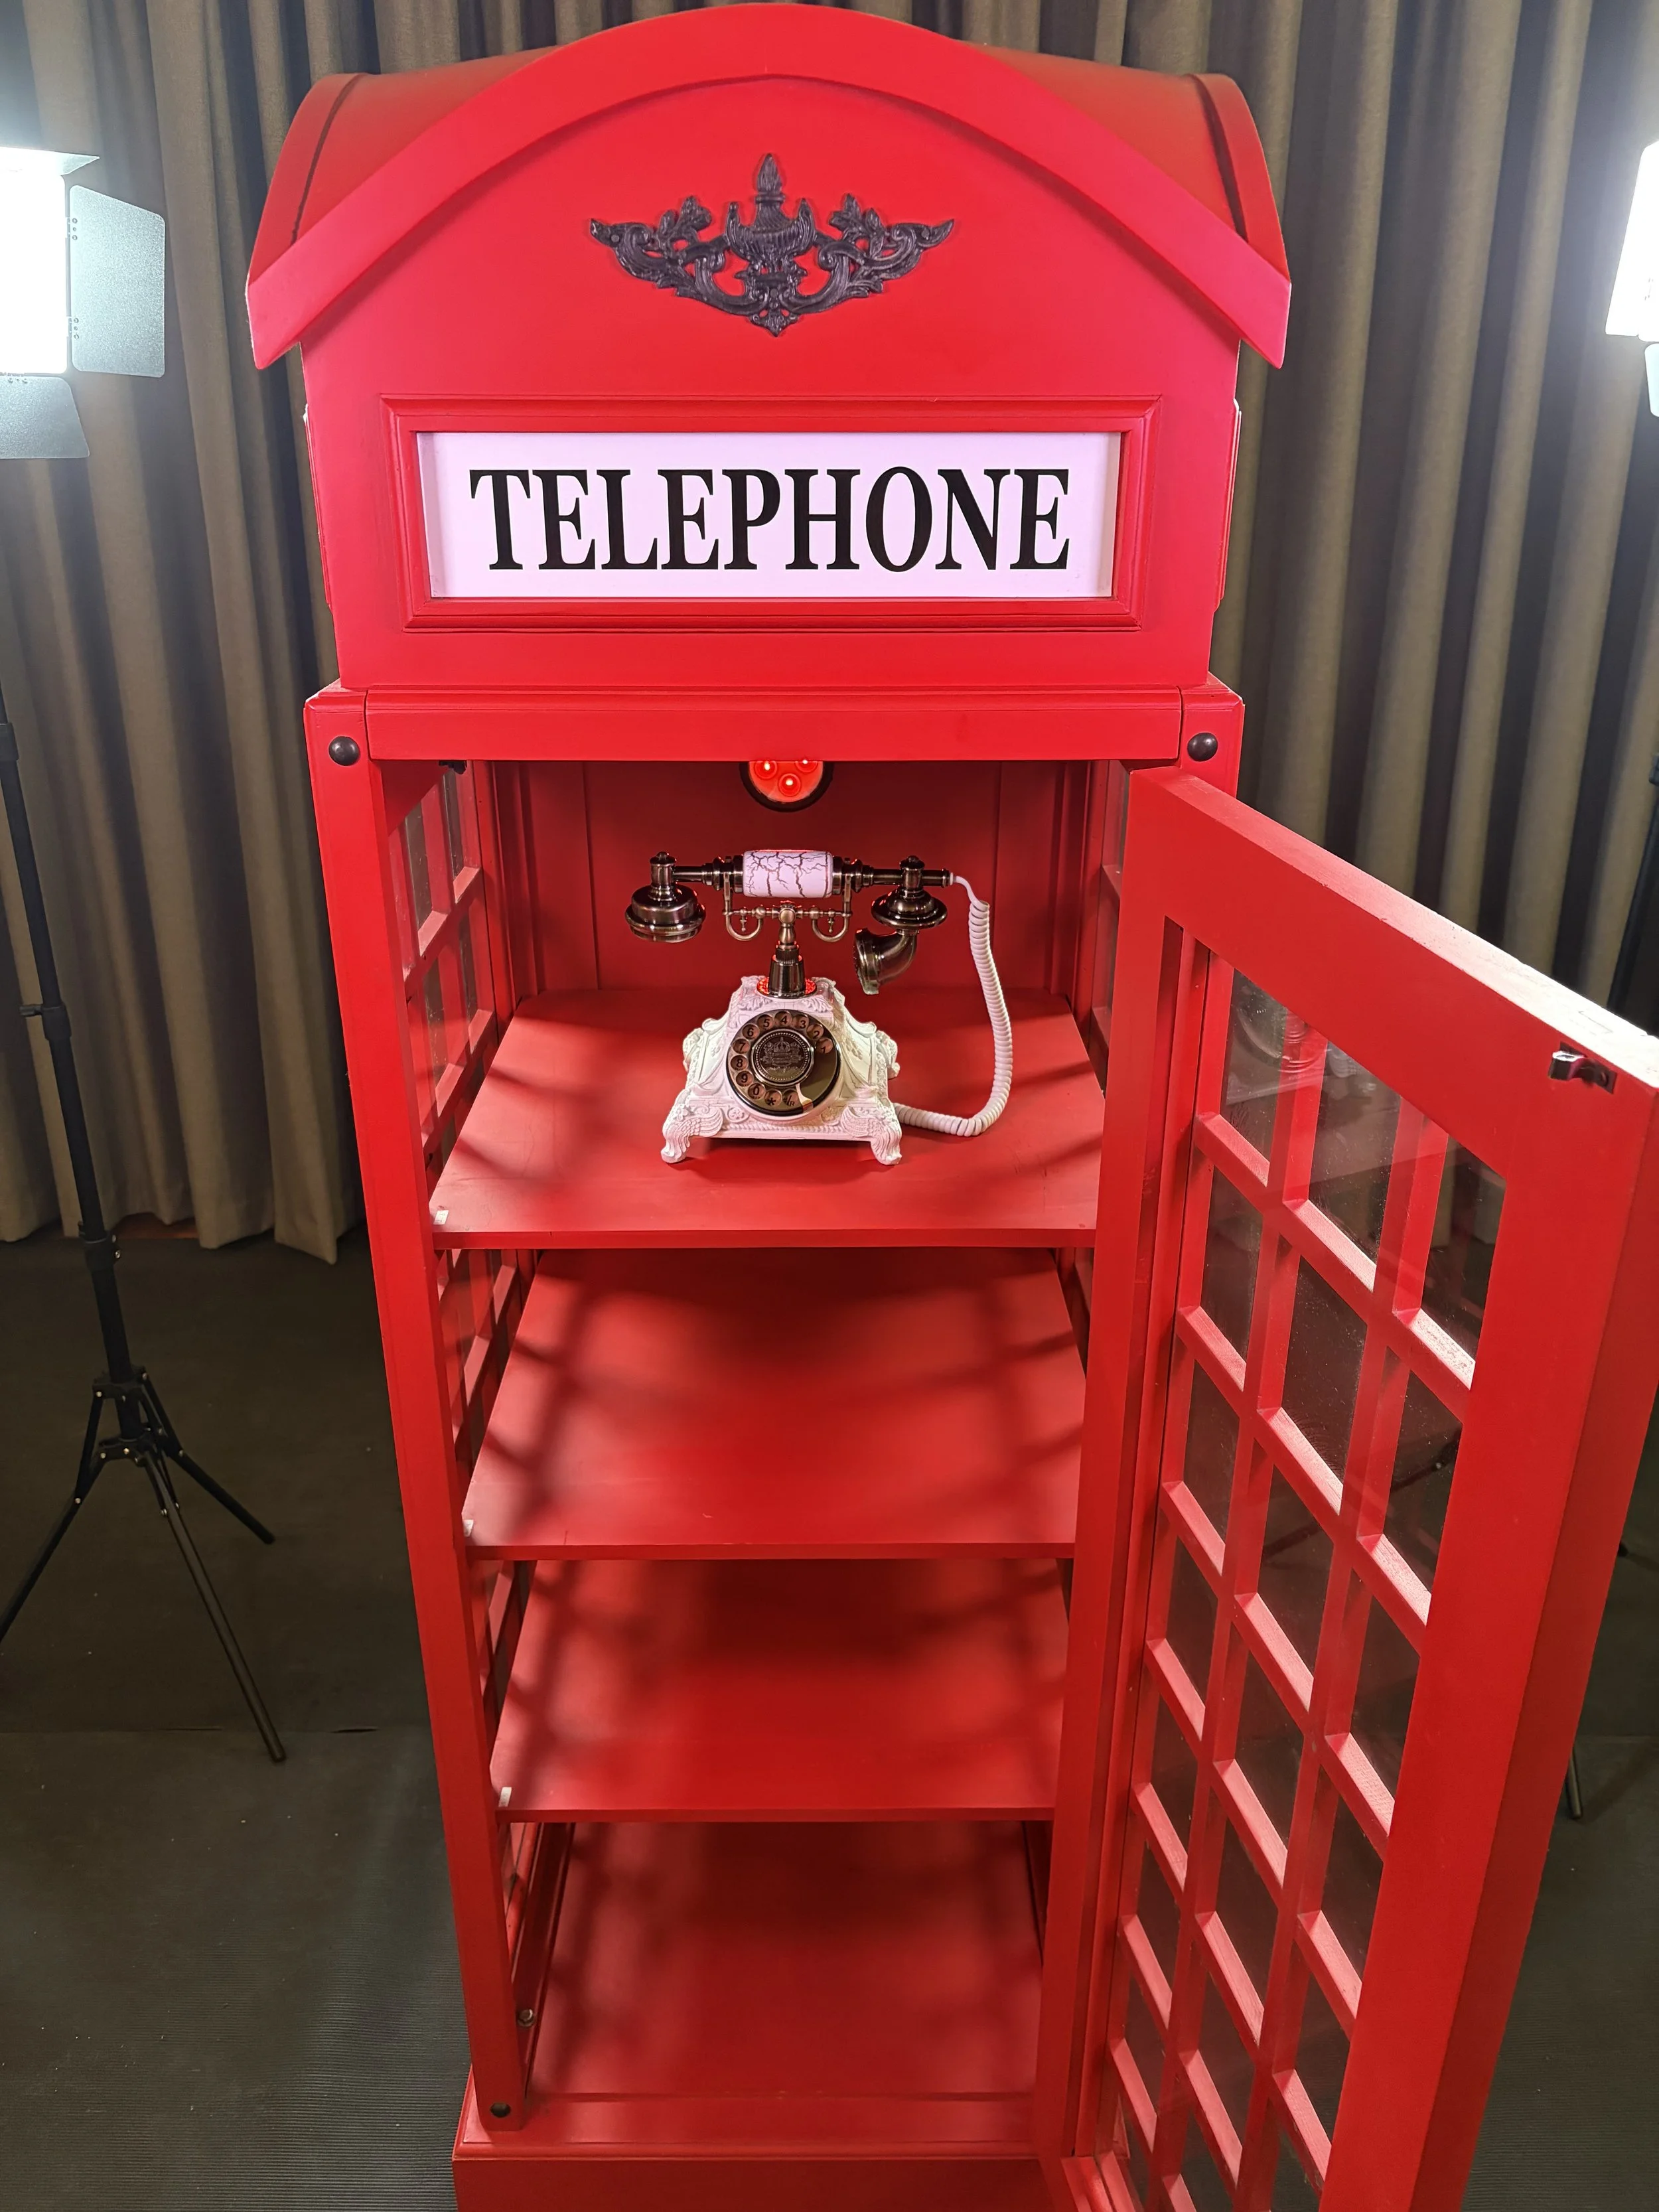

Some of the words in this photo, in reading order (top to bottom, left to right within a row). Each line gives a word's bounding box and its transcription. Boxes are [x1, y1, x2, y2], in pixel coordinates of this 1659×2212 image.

[469, 466, 1070, 573] TELEPHONE
[763, 1018, 770, 1027] 5
[780, 1015, 787, 1025] 4
[799, 1020, 806, 1029] 3
[747, 1027, 754, 1037] 6
[813, 1030, 820, 1039] 2
[739, 1041, 746, 1052] 7
[820, 1045, 826, 1054] 1
[737, 1058, 743, 1068] 8
[741, 1073, 748, 1083] 9
[753, 1086, 760, 1096] 0
